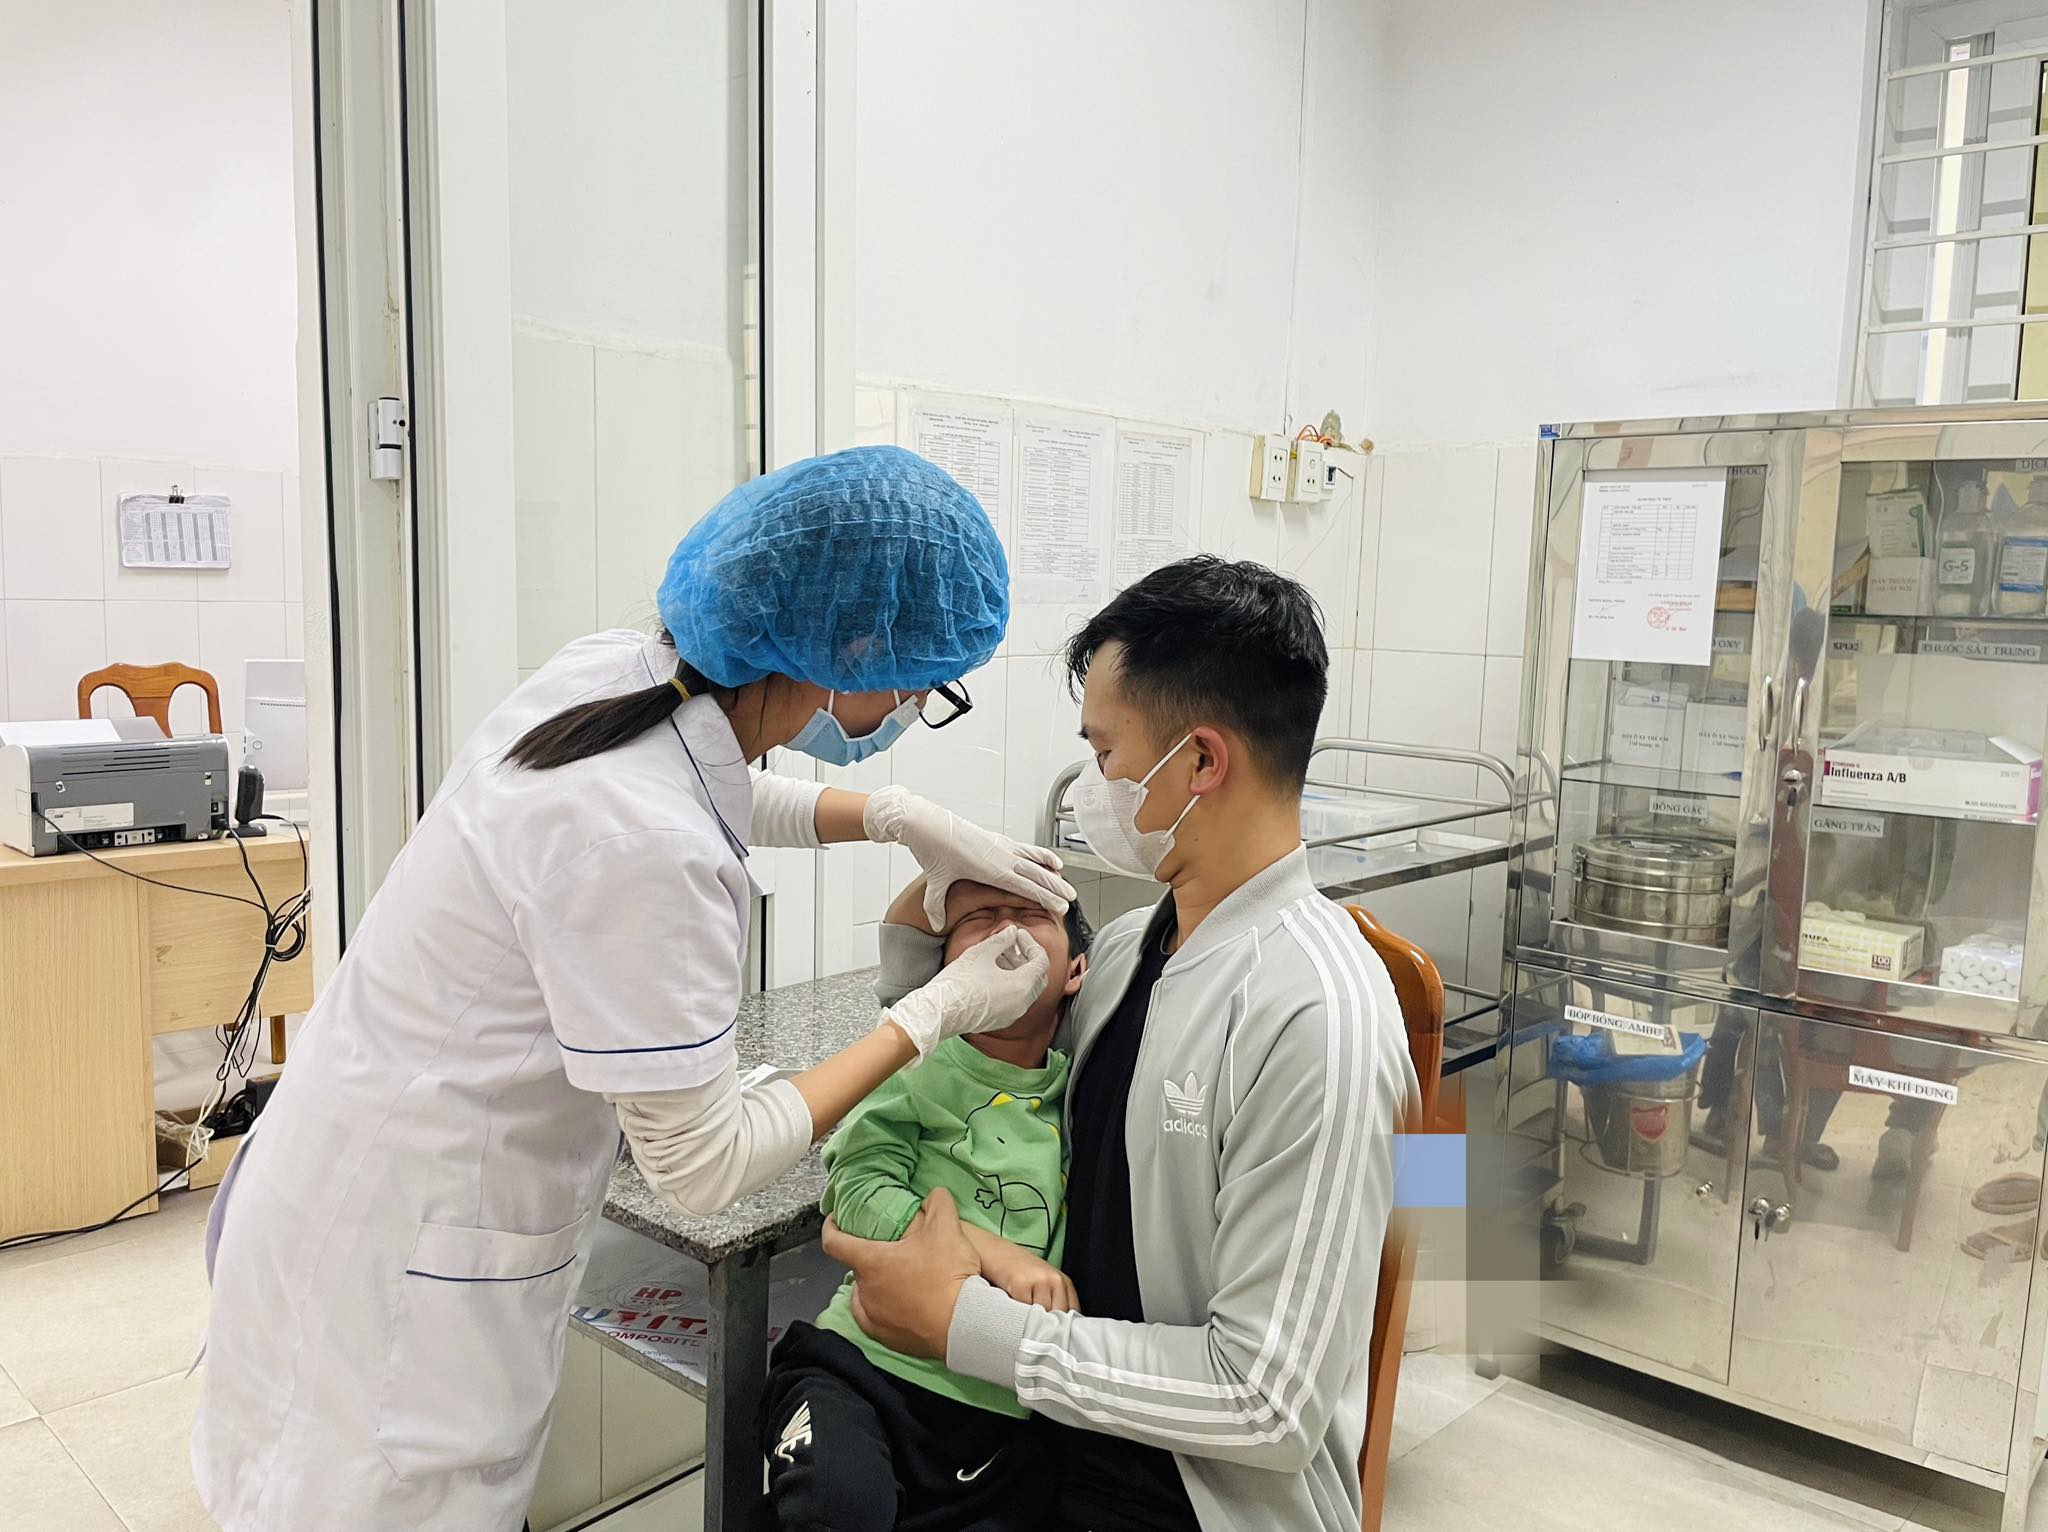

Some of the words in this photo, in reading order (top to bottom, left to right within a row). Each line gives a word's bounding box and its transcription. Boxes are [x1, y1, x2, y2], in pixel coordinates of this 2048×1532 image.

[1943, 560, 1969, 572] G-5
[1718, 639, 1741, 649] OXY
[1831, 767, 1883, 782] Influenza
[1887, 772, 1907, 783] A/B
[1873, 954, 1890, 965] 100
[1163, 1117, 1208, 1139] adidas
[634, 1286, 682, 1300] HP
[607, 1330, 701, 1346] OMPOSITE
